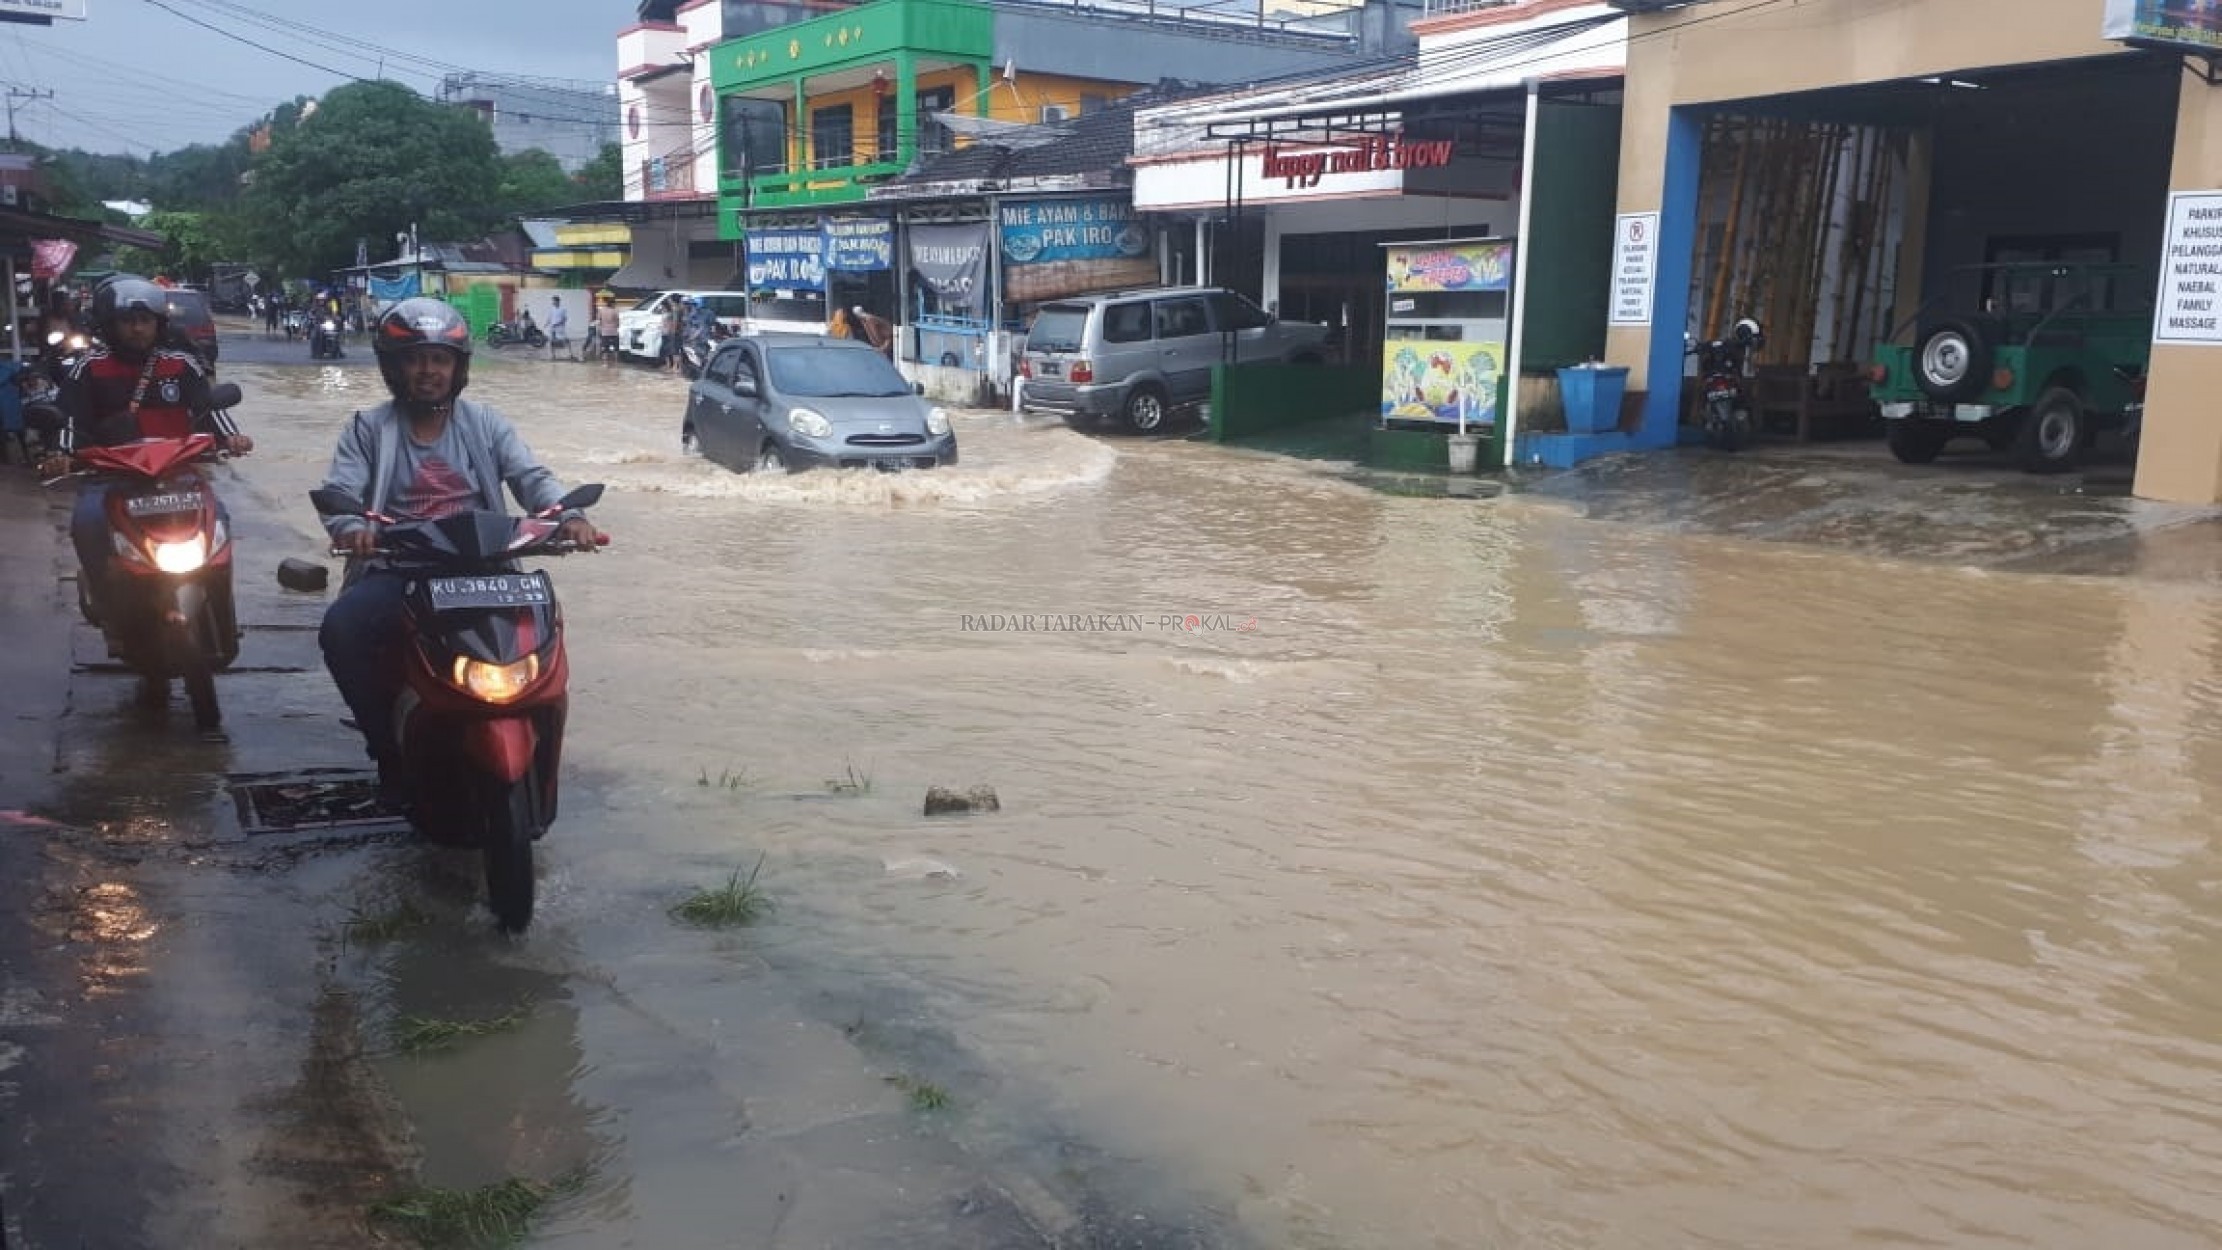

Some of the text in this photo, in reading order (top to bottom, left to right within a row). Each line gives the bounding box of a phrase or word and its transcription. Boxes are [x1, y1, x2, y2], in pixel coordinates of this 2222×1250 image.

[1263, 147, 1326, 189] Happy
[1331, 138, 1373, 172] nail
[1393, 134, 1452, 169] brow
[1037, 205, 1077, 224] AYAM
[1043, 226, 1112, 247] PAK IRO
[2177, 299, 2212, 311] FAMILY
[2169, 317, 2217, 329] MASSAGE
